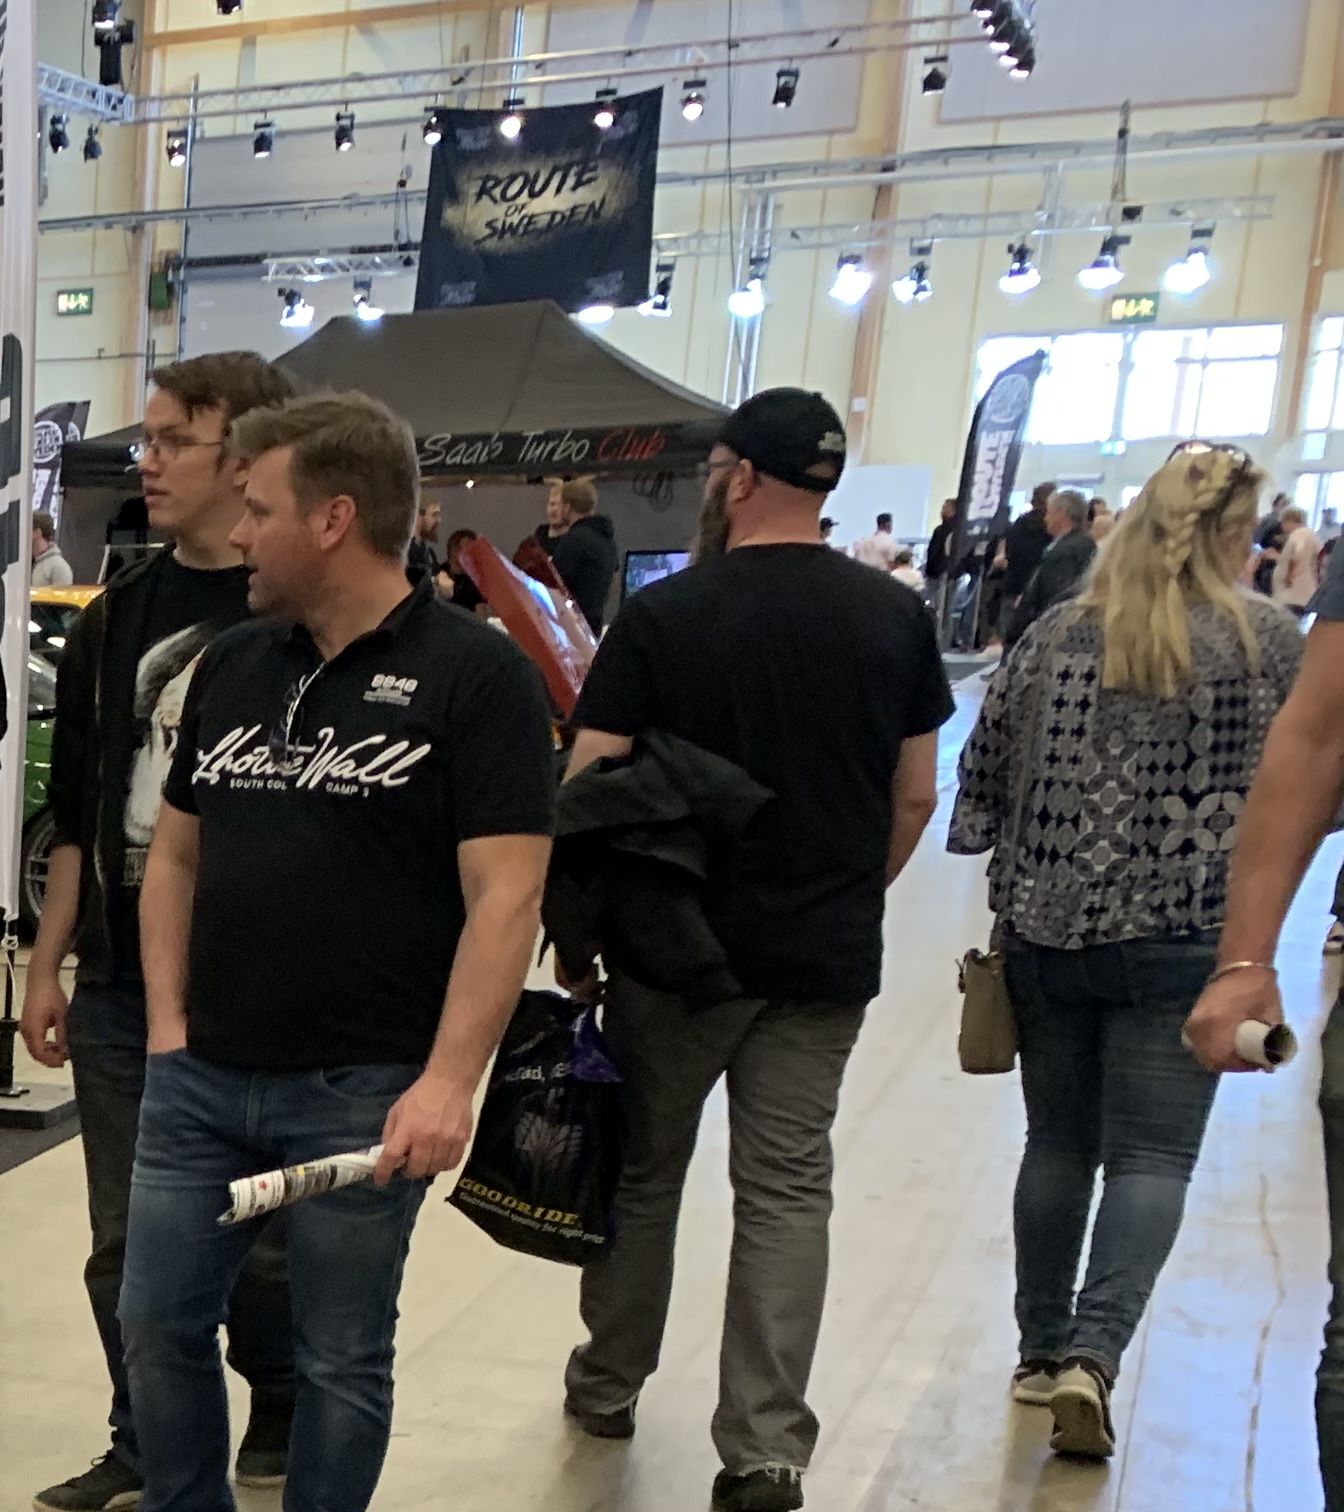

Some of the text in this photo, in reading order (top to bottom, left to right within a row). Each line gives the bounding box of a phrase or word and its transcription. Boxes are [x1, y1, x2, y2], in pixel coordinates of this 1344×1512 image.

[475, 160, 600, 204] ROUTE
[474, 197, 606, 245] SWEDEN
[505, 202, 529, 217] OF
[419, 428, 667, 466] Saab Turbo Club
[296, 726, 431, 789] Wall
[230, 778, 264, 790] SOUTH
